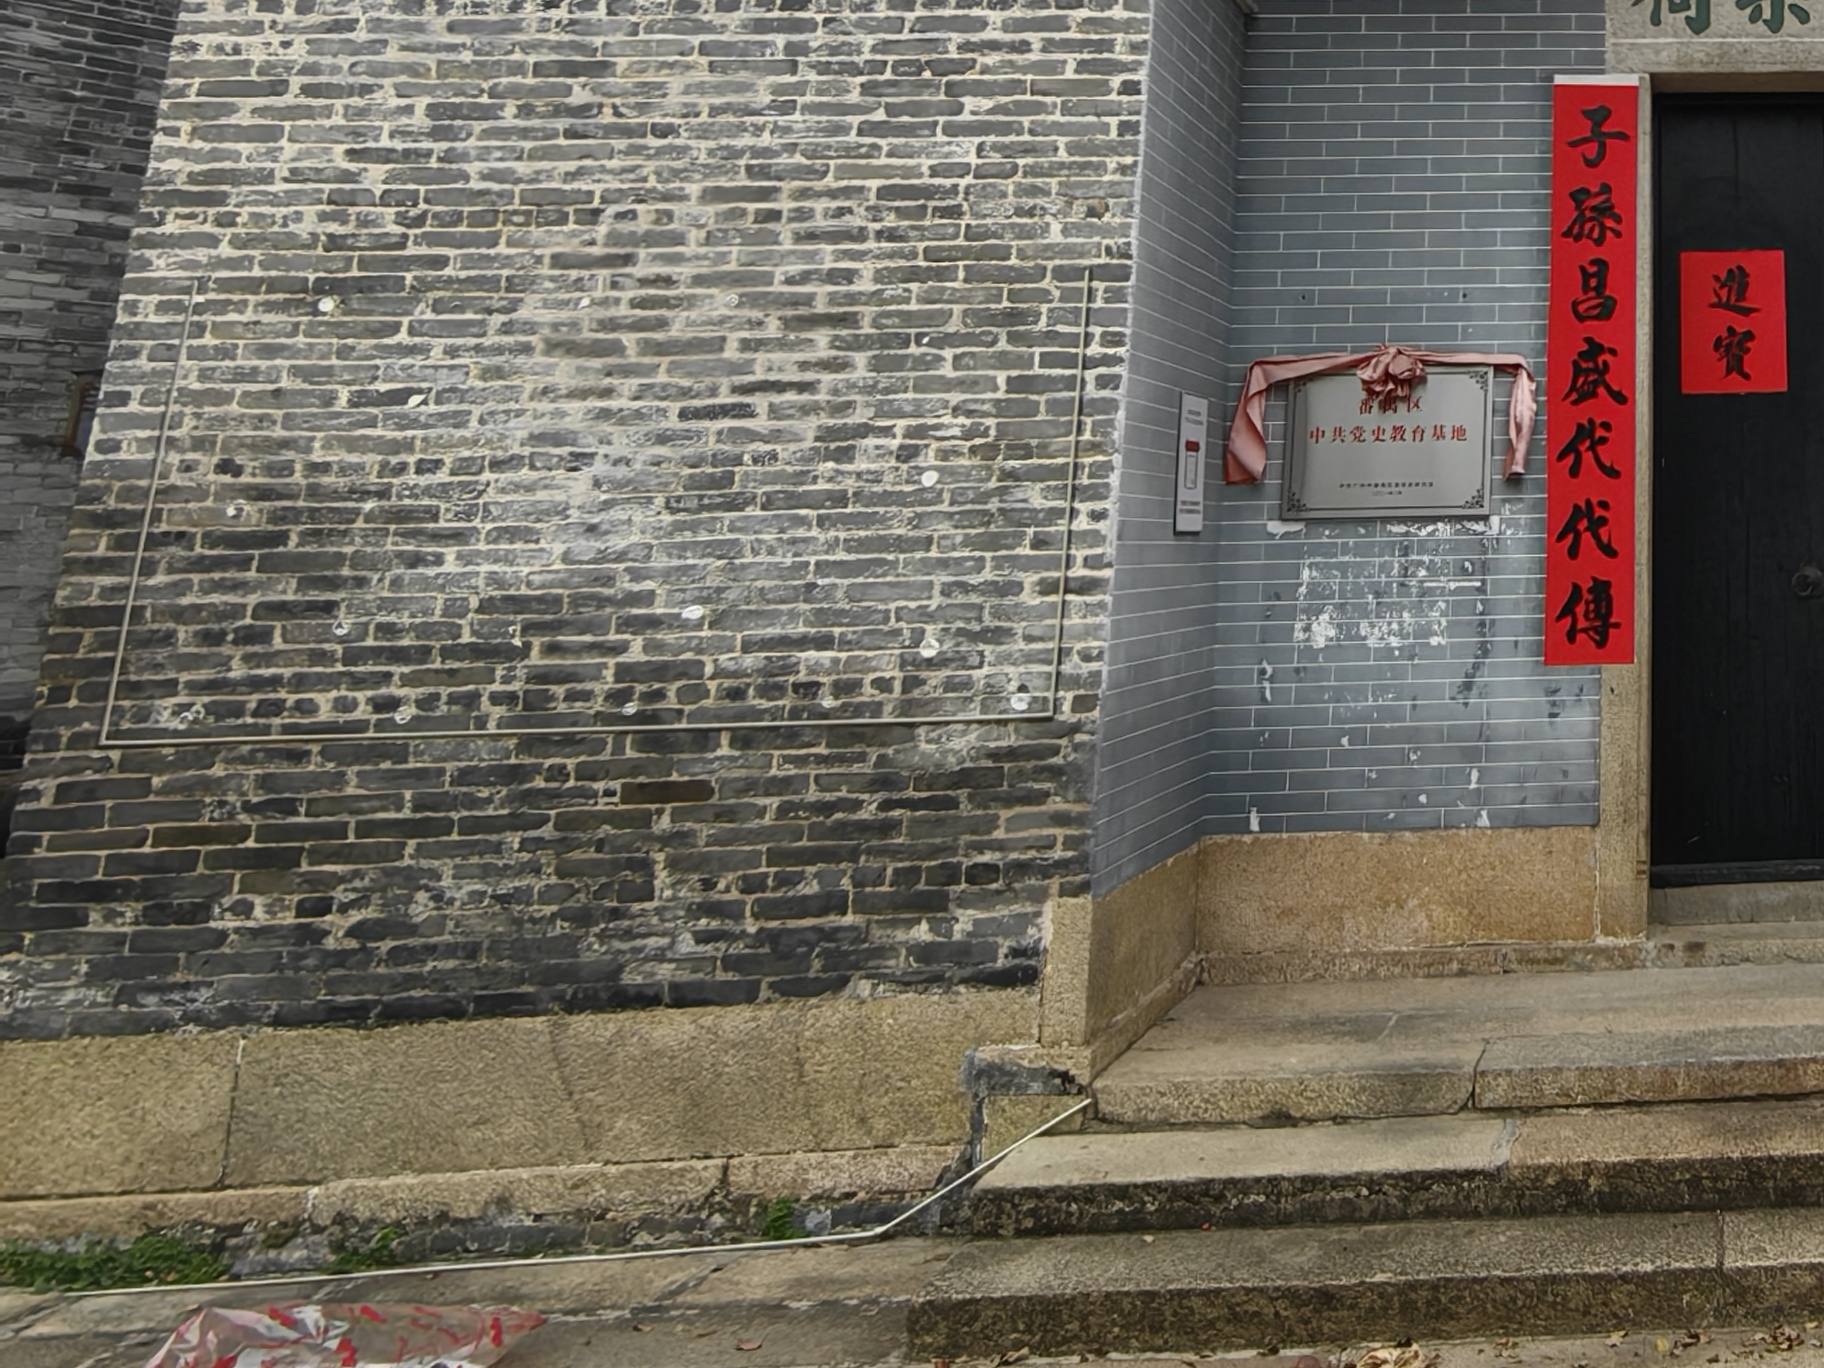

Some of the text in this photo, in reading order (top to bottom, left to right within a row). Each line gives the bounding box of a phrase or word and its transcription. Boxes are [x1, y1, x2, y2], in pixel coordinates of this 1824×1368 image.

[1309, 424, 1468, 444] 中共党史教育基地
[1555, 104, 1630, 650] 子孫昌盛代代傳
